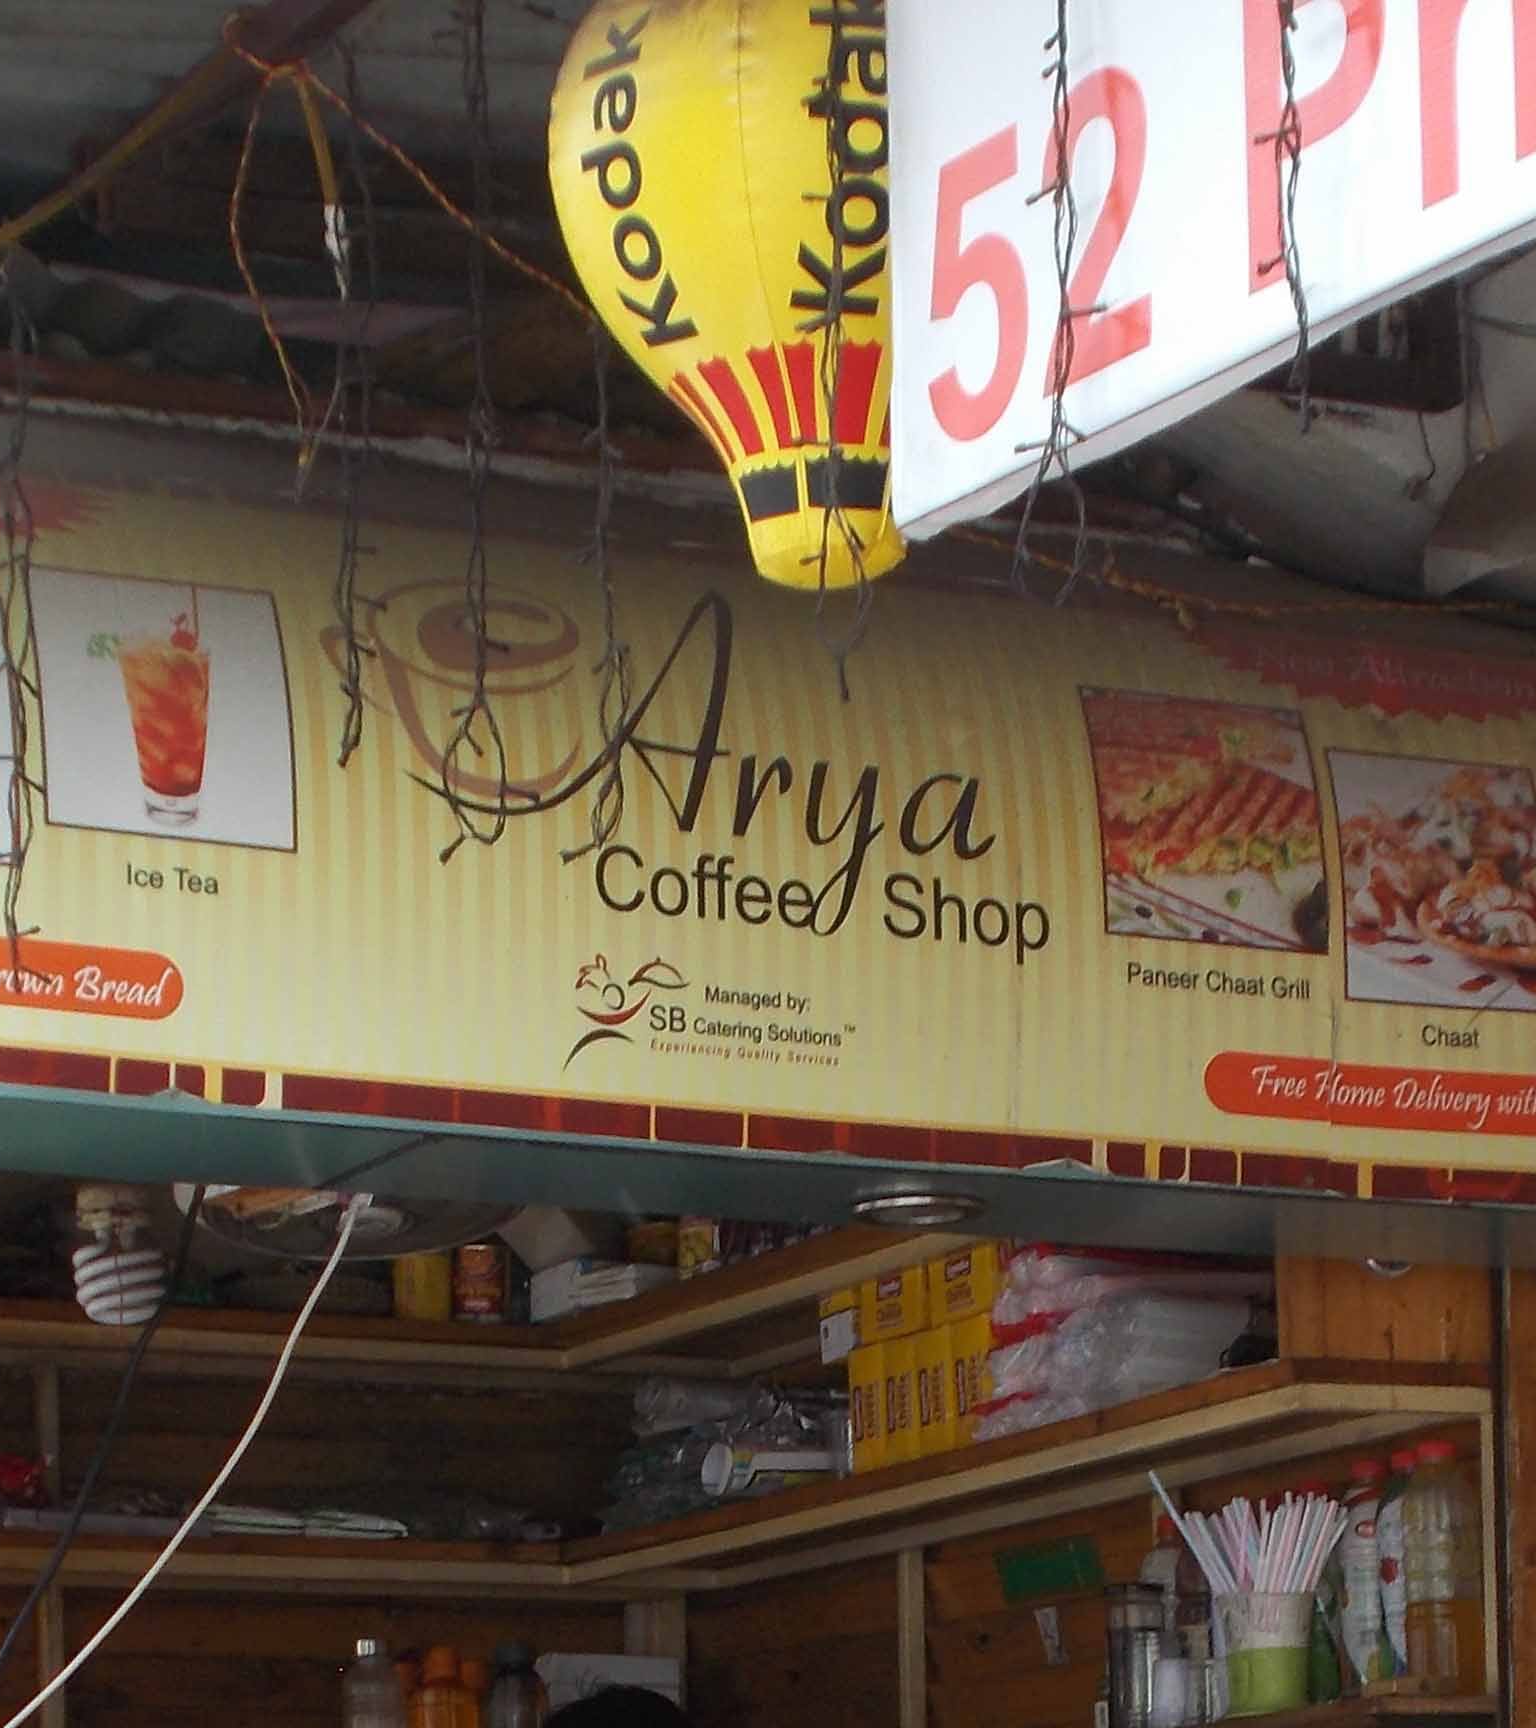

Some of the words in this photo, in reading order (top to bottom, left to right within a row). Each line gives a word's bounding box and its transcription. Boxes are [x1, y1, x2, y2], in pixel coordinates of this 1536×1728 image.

[580, 6, 700, 348] Kodak
[928, 66, 1153, 442] 52
[405, 590, 997, 938] Arya
[126, 863, 163, 890] Ice
[172, 867, 220, 896] Tea
[594, 845, 817, 930] Coffee
[882, 872, 1052, 964] Shop
[75, 966, 175, 1007] Bread
[704, 985, 783, 1013] Managed
[1127, 961, 1200, 994] Paneer
[1205, 968, 1265, 997] Chaat
[1270, 973, 1311, 1000] Grill
[649, 1004, 687, 1033] SB
[693, 1016, 763, 1044] Catering
[1421, 1022, 1480, 1050] Chaat
[1251, 1064, 1307, 1099] Free
[1314, 1066, 1385, 1108] Home
[1392, 1077, 1493, 1131] Delivery
